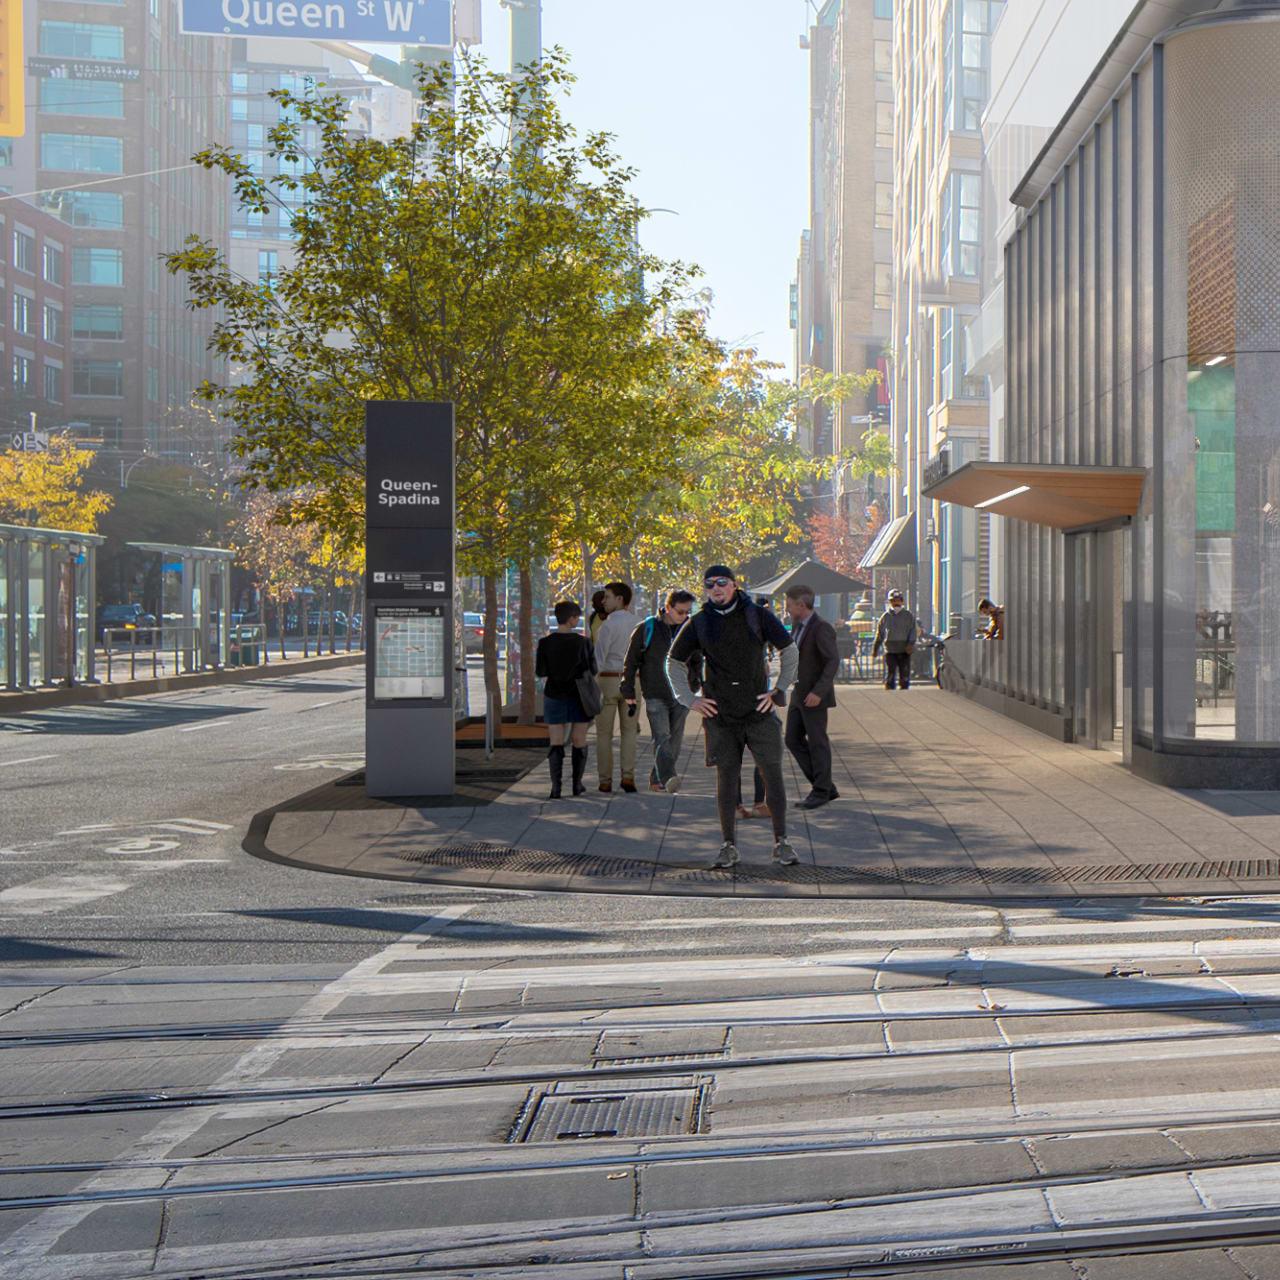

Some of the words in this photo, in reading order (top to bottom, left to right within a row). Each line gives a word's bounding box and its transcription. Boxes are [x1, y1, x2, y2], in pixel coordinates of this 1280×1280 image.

[356, 0, 376, 18] St
[383, 0, 415, 33] W
[380, 478, 438, 492] Queen-
[378, 493, 441, 508] Spadina
